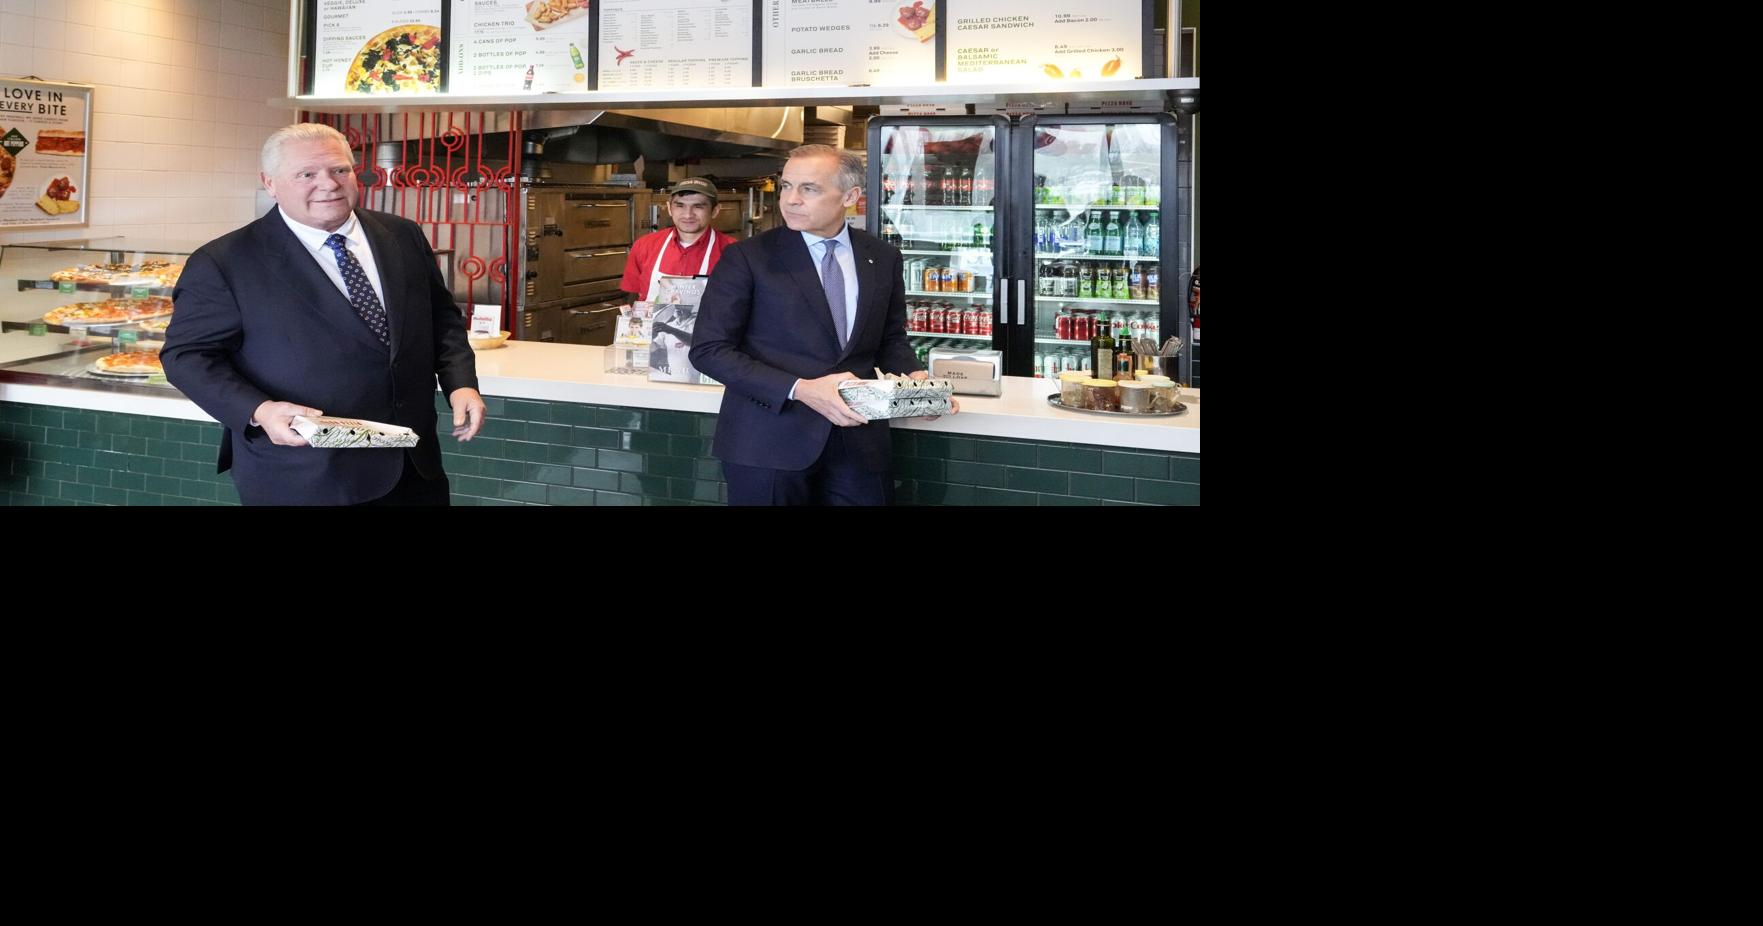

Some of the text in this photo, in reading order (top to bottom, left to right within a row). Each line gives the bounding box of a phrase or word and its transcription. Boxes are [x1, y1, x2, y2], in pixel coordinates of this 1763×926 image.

[957, 15, 1030, 25] GRILLED CHICKEN
[990, 22, 1035, 30] SANDWICH
[4, 87, 63, 103] LOVE IN
[0, 100, 67, 116] EVERY BITE
